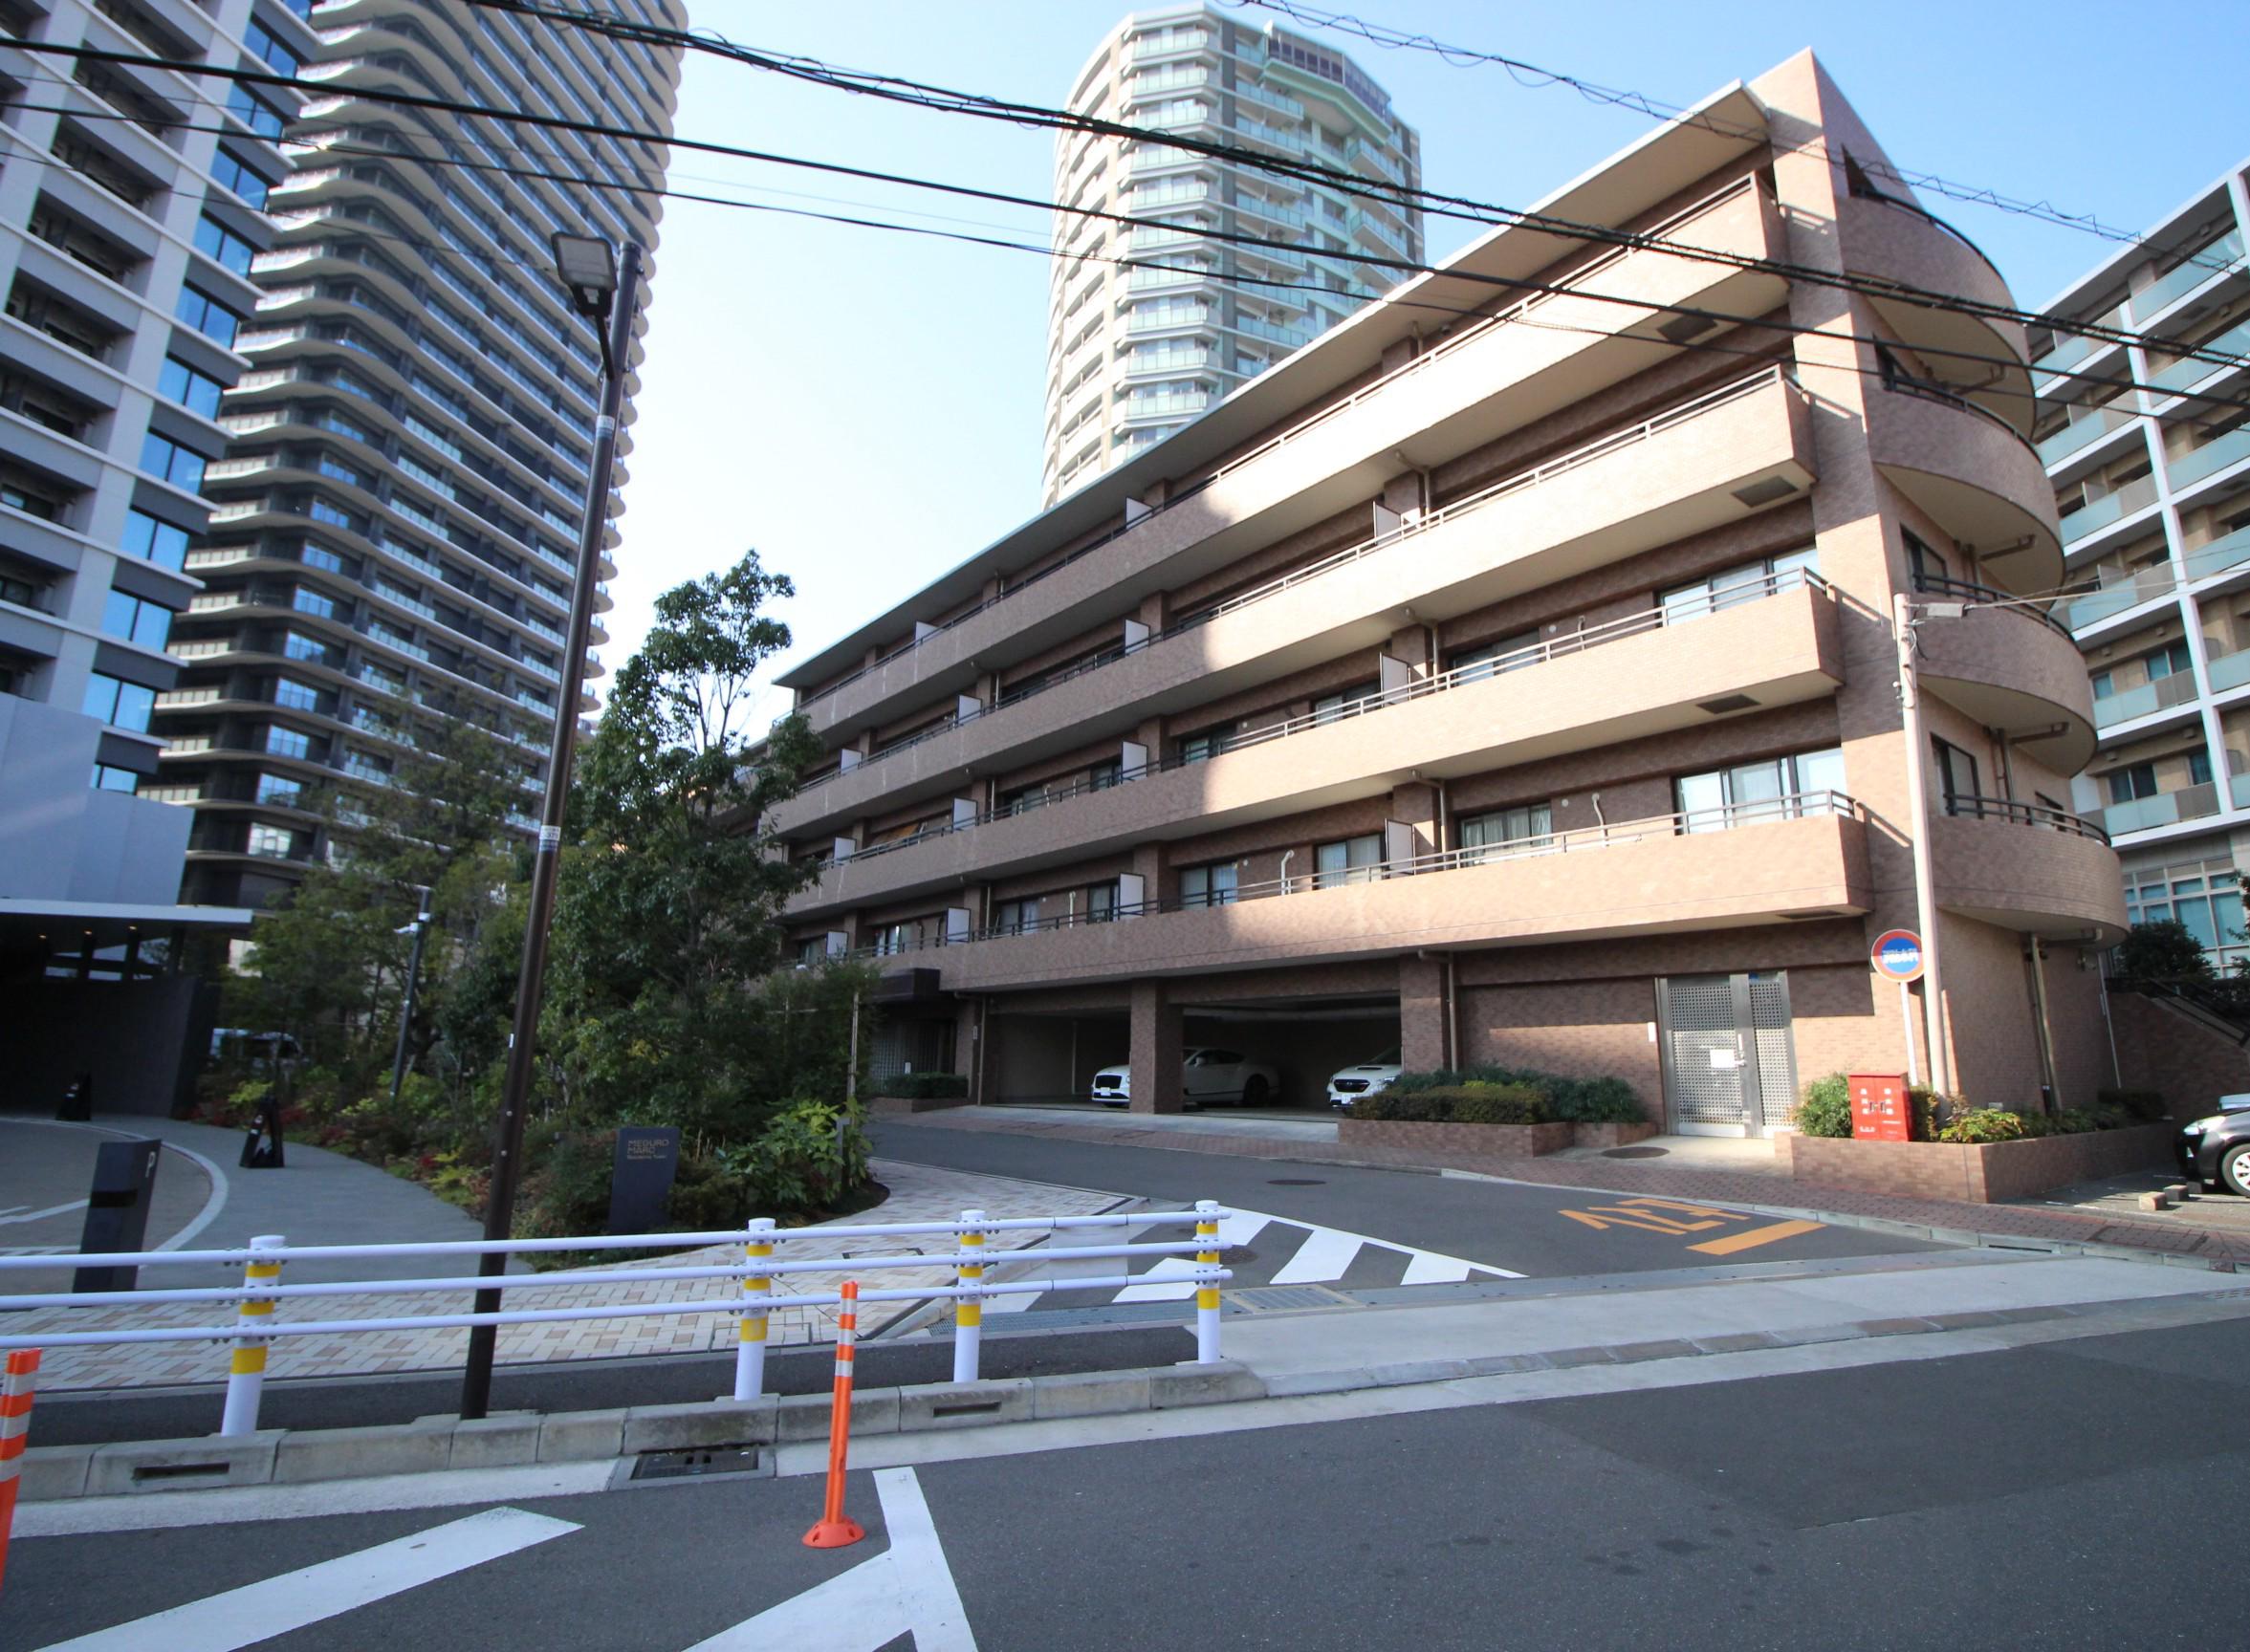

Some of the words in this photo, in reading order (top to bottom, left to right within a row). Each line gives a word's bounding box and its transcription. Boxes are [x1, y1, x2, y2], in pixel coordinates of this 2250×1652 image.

[144, 1151, 157, 1178] P
[1558, 1198, 1751, 1235] トマレ
